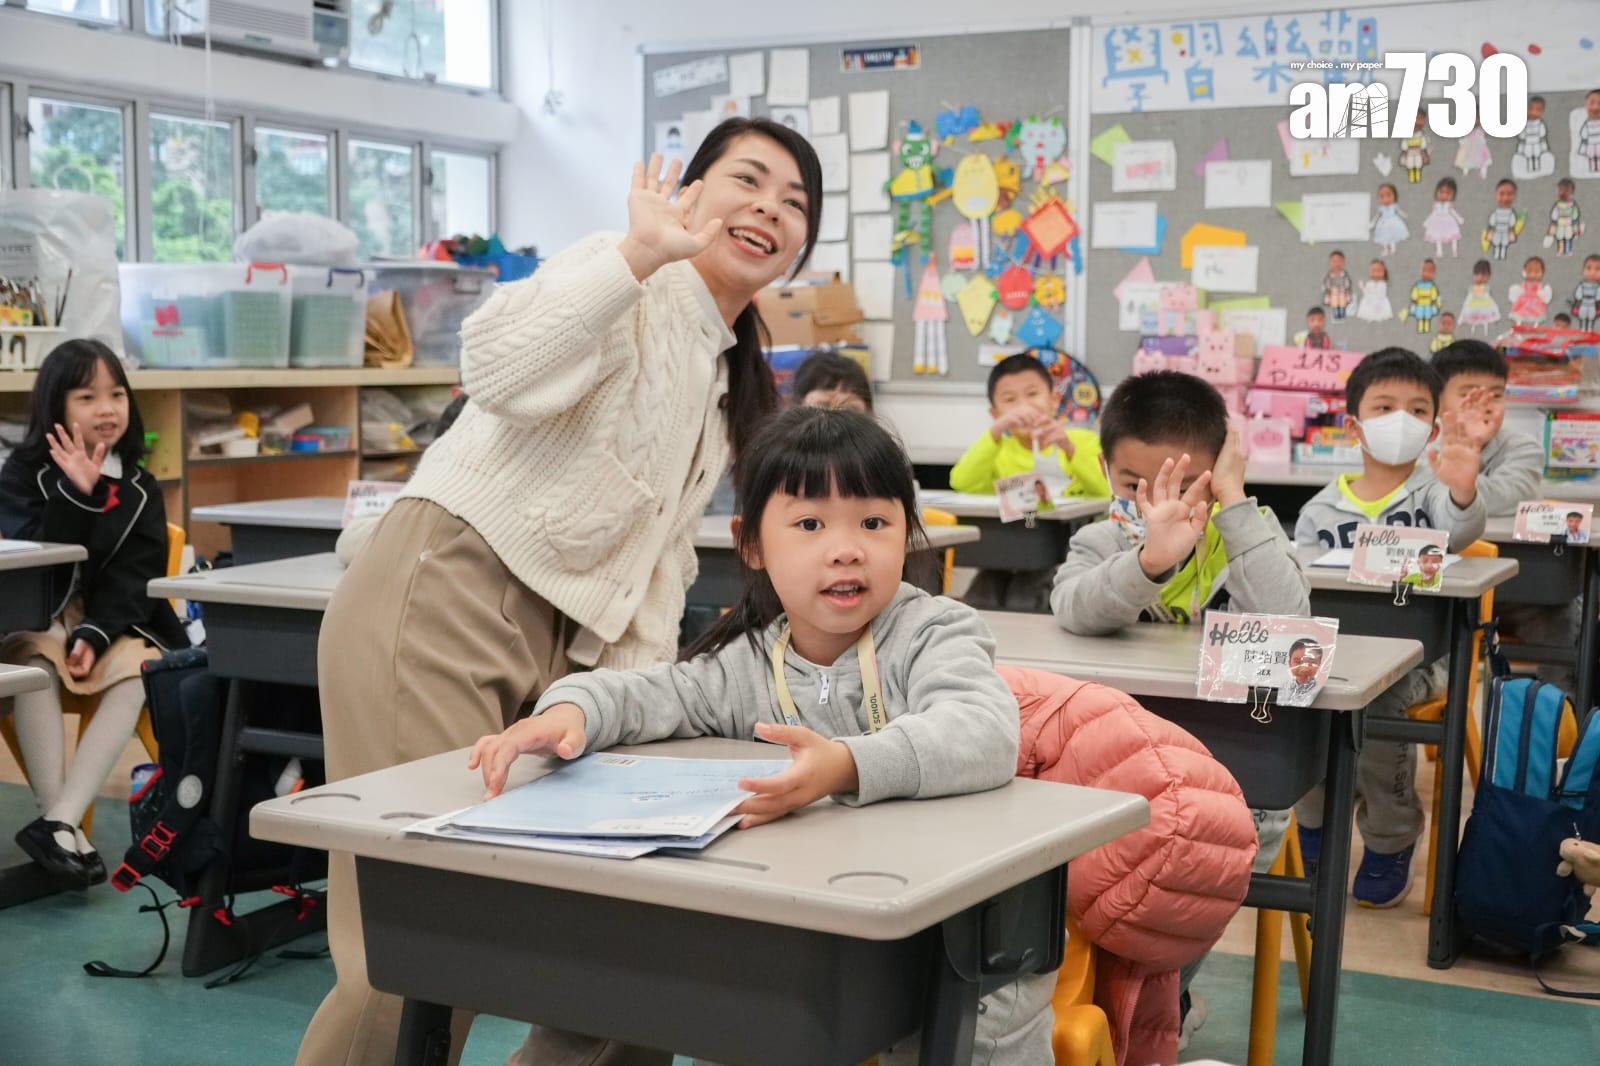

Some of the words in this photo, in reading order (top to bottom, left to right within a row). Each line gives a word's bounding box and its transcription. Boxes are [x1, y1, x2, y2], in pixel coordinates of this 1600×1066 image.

[1358, 529, 1400, 548] Hello
[1209, 621, 1269, 646] Hello
[870, 693, 881, 725] SCHOOL
